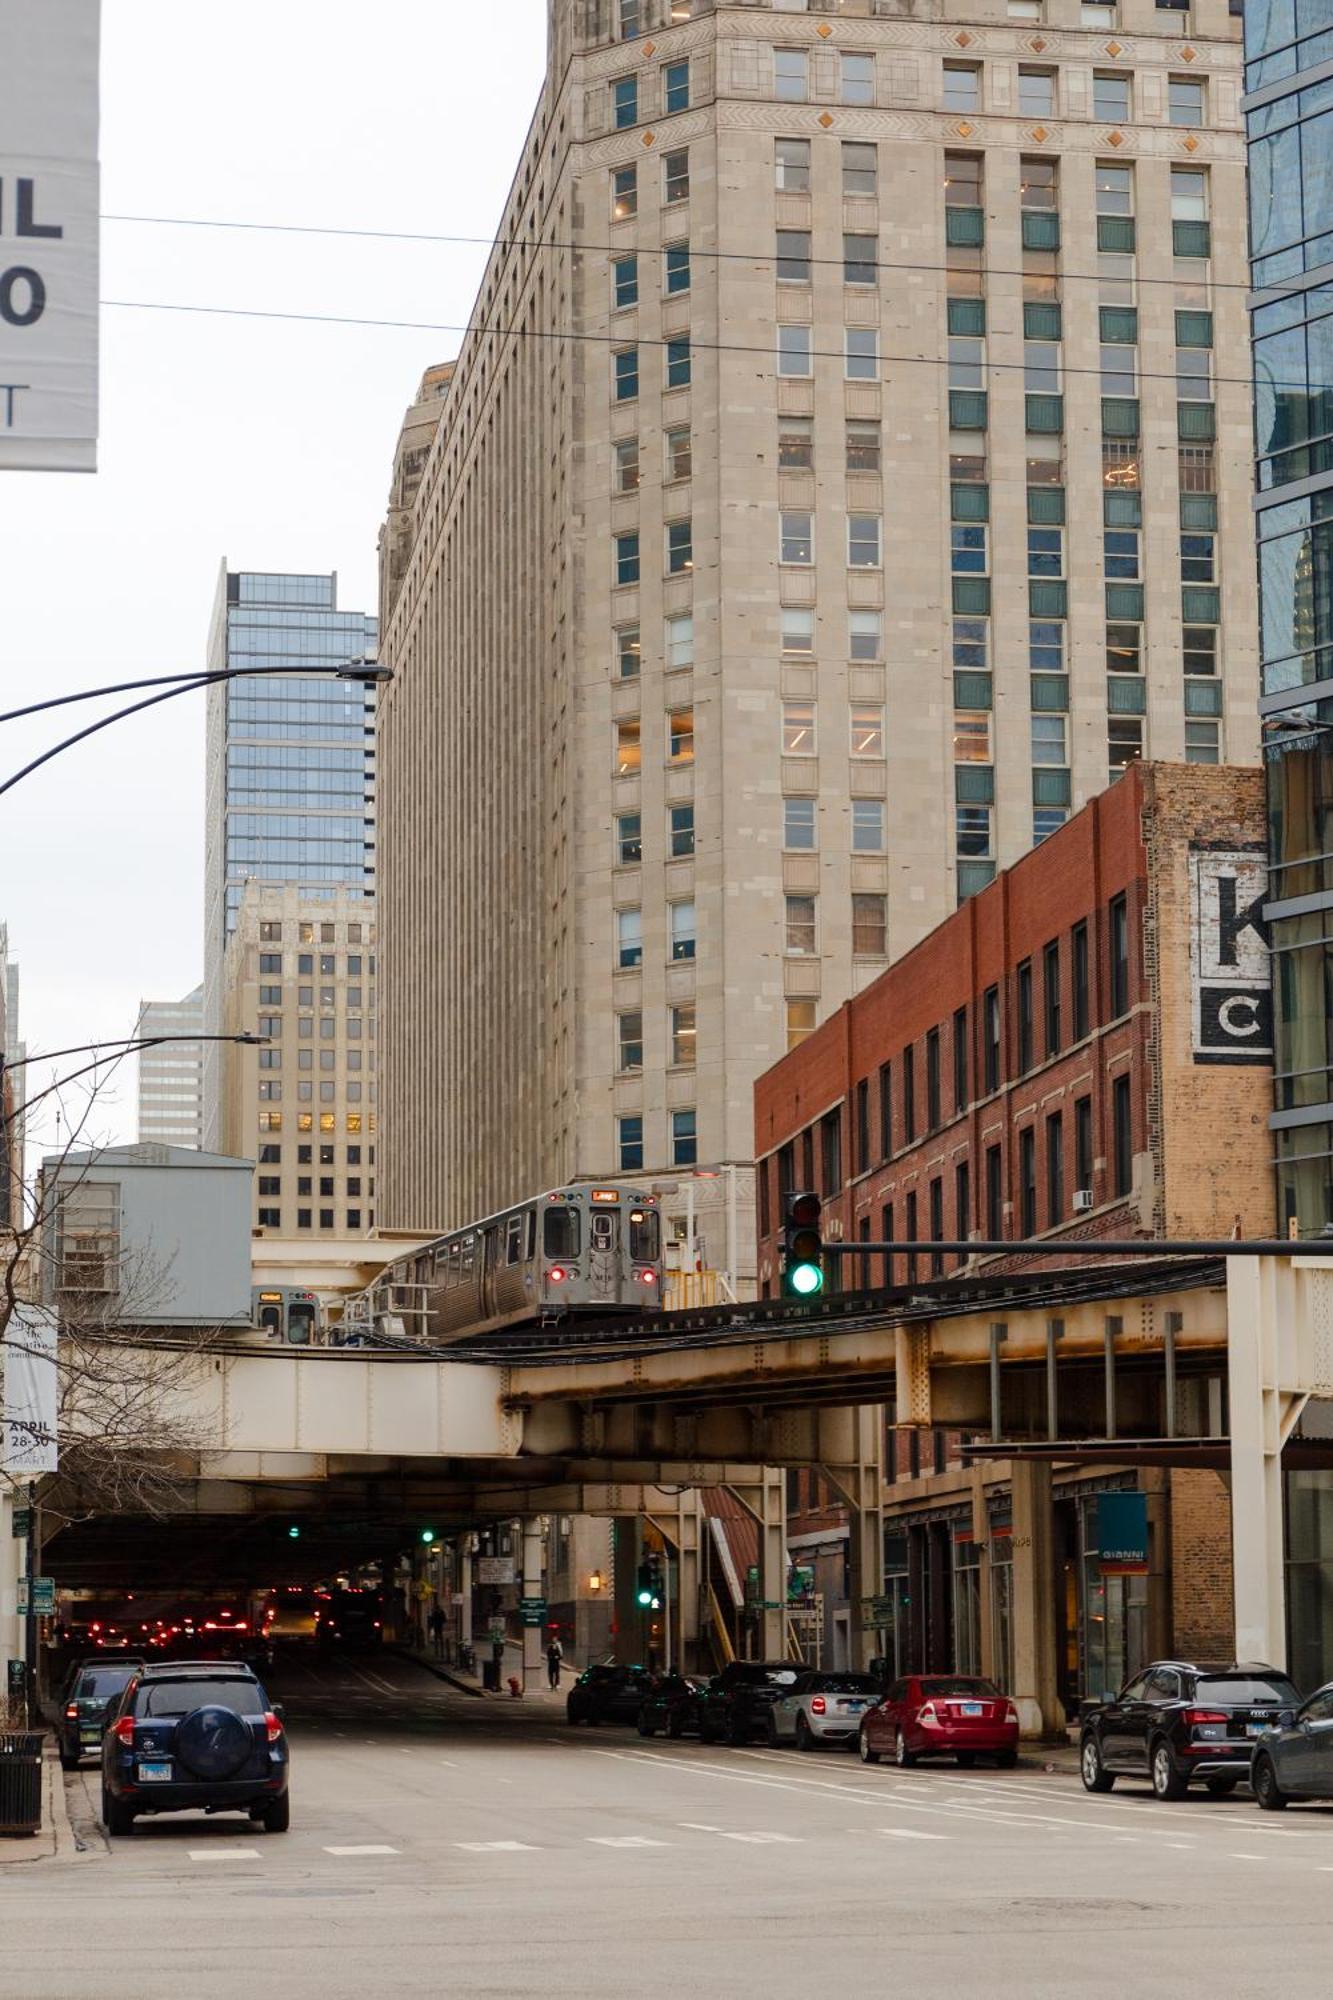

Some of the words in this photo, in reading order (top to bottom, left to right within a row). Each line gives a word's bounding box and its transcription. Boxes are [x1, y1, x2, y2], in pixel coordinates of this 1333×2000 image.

[1218, 995, 1261, 1037] C
[9, 1421, 51, 1432] APRIL
[12, 1436, 49, 1447] 28-30
[13, 1456, 45, 1465] MART
[1103, 1549, 1144, 1559] GIANNI
